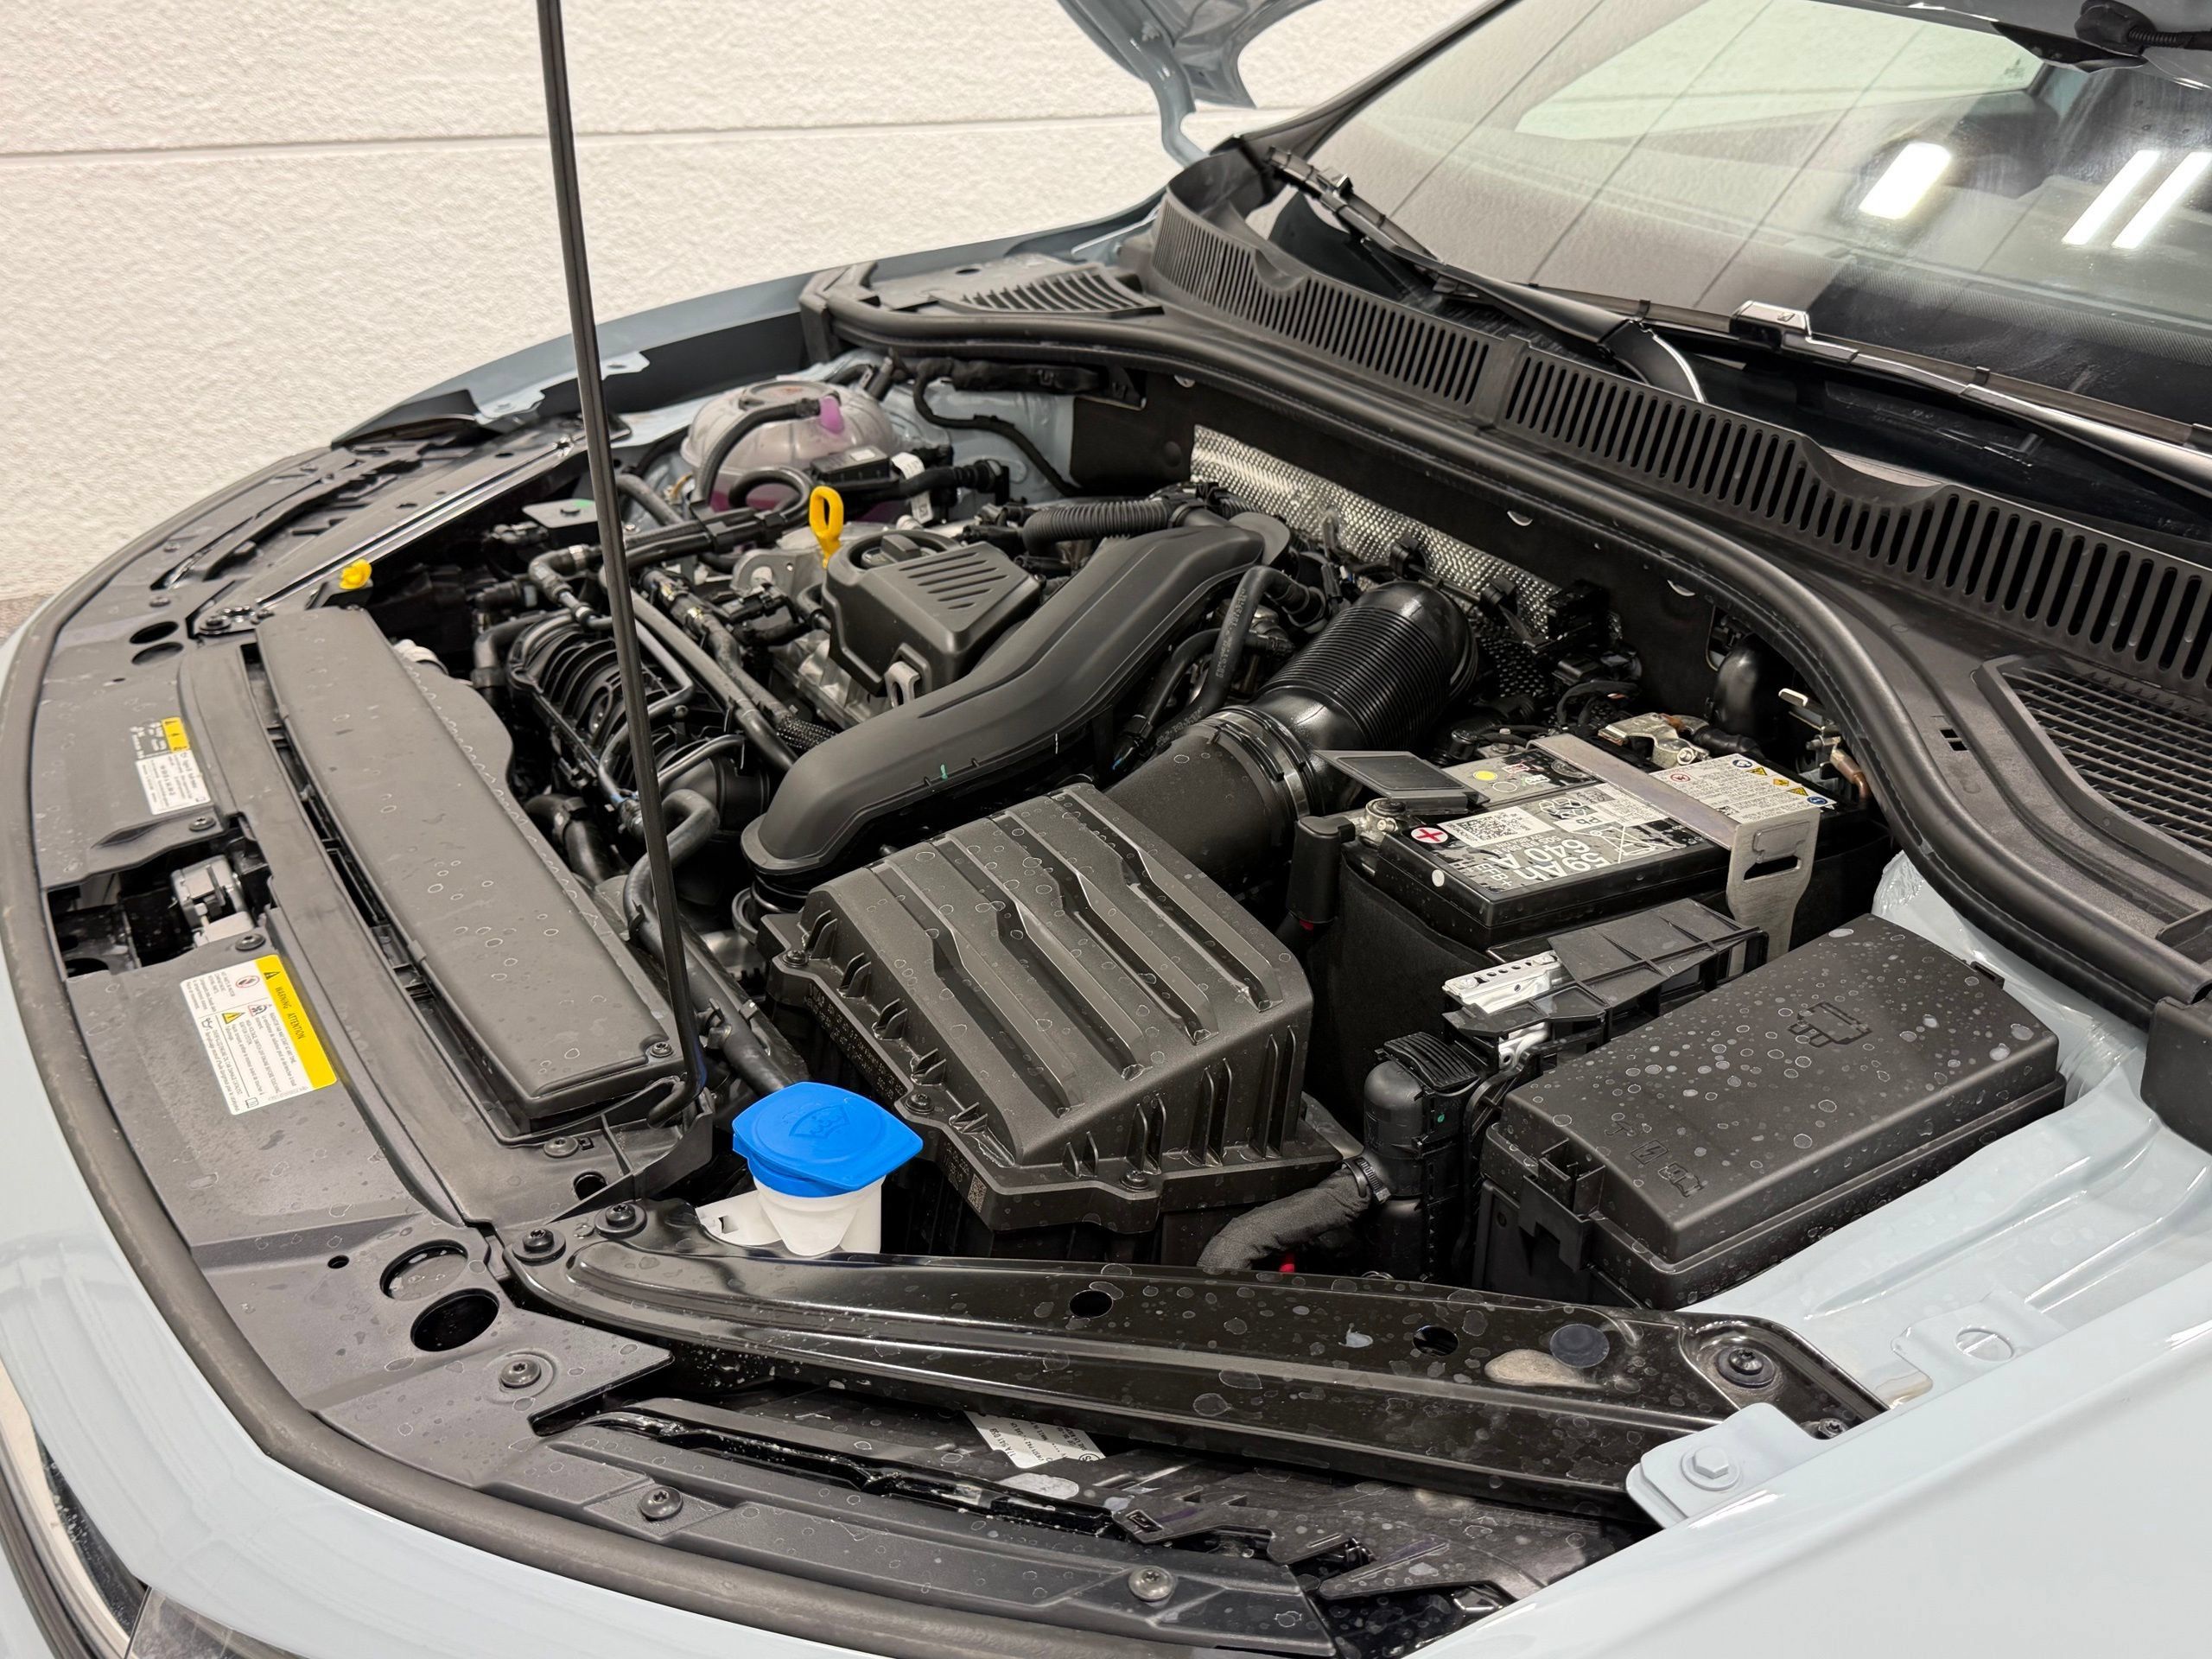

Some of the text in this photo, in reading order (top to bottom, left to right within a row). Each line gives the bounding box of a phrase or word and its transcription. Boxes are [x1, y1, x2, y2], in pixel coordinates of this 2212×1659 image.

[1576, 816, 1603, 824] Pb
[1486, 852, 1522, 869] A
[1523, 839, 1591, 862] 640
[1472, 862, 1512, 887] EFB+
[1513, 852, 1610, 881] 59Ah
[275, 986, 292, 1009] WARNING
[287, 1013, 306, 1040] ATTENTION
